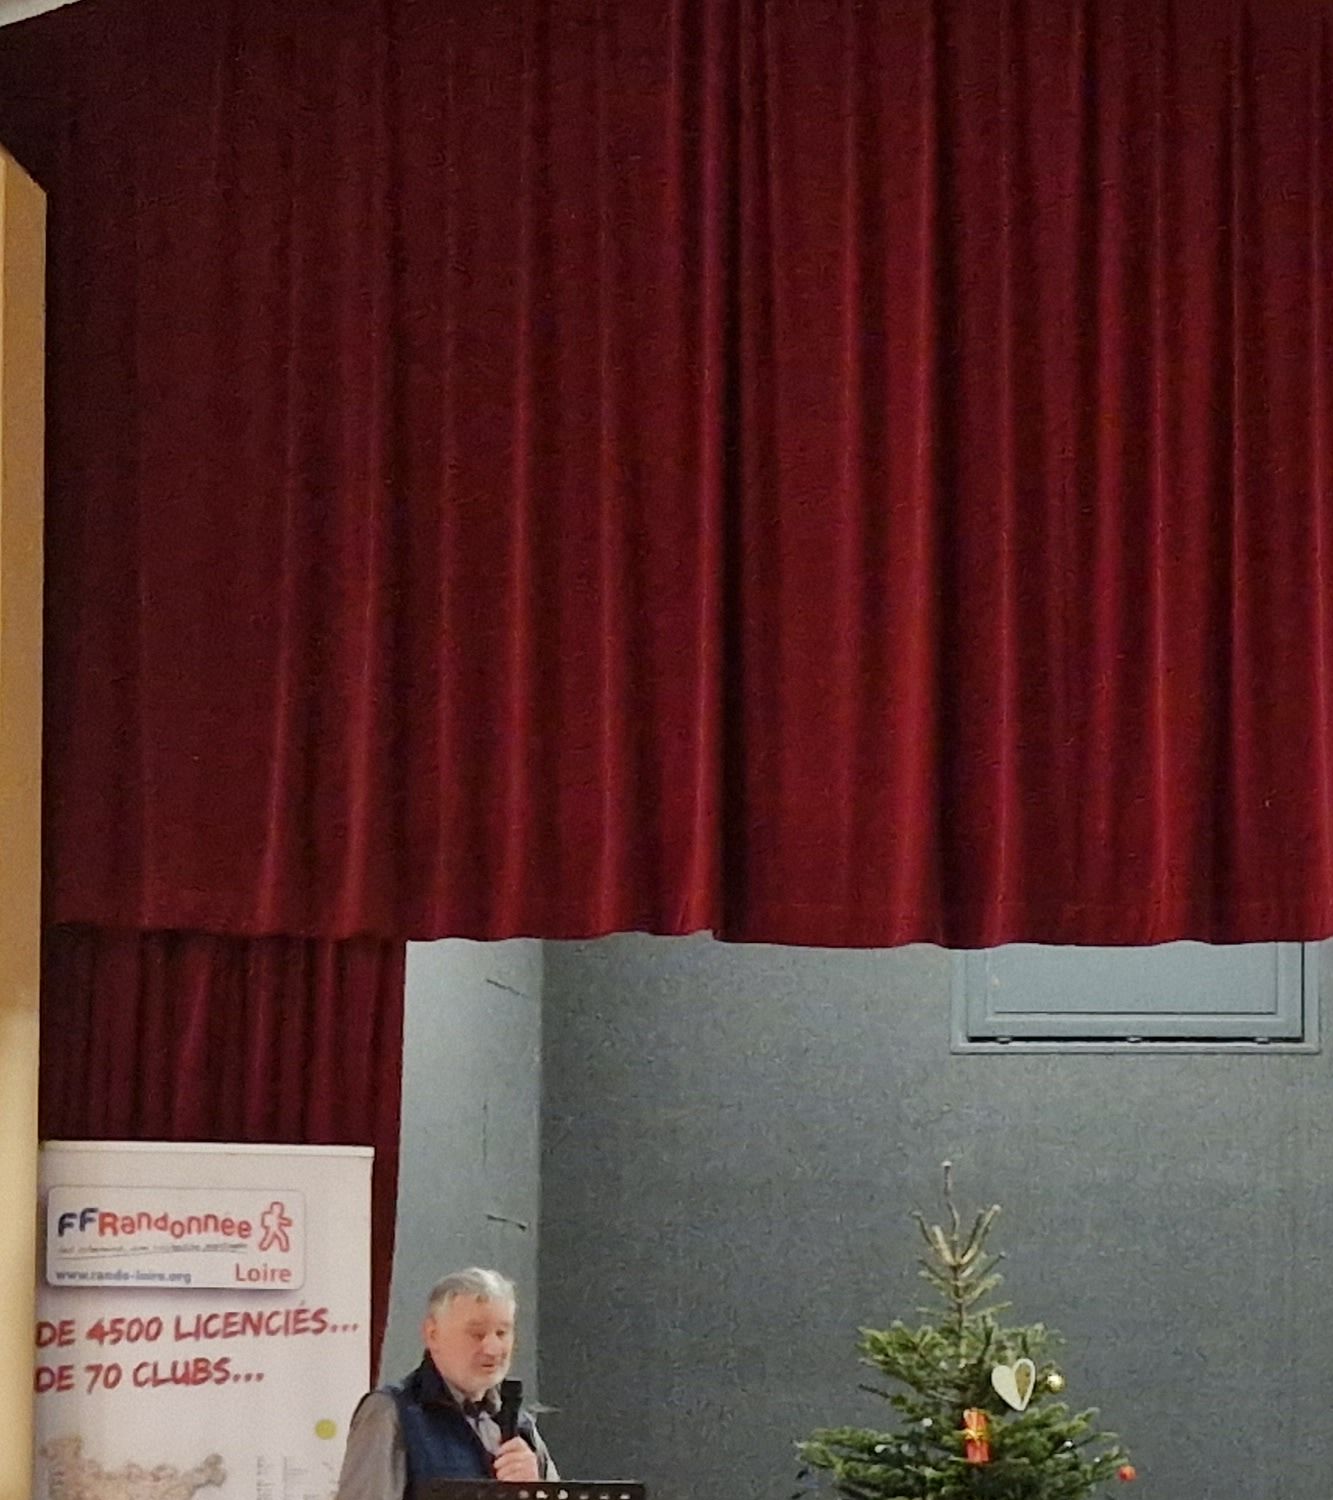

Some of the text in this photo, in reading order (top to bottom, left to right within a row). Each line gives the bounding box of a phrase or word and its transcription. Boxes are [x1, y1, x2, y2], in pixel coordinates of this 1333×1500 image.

[236, 1263, 291, 1283] Loire
[35, 1320, 75, 1348] DE
[86, 1317, 163, 1346] 4500
[34, 1357, 265, 1394] DE 70 CLUBS...
